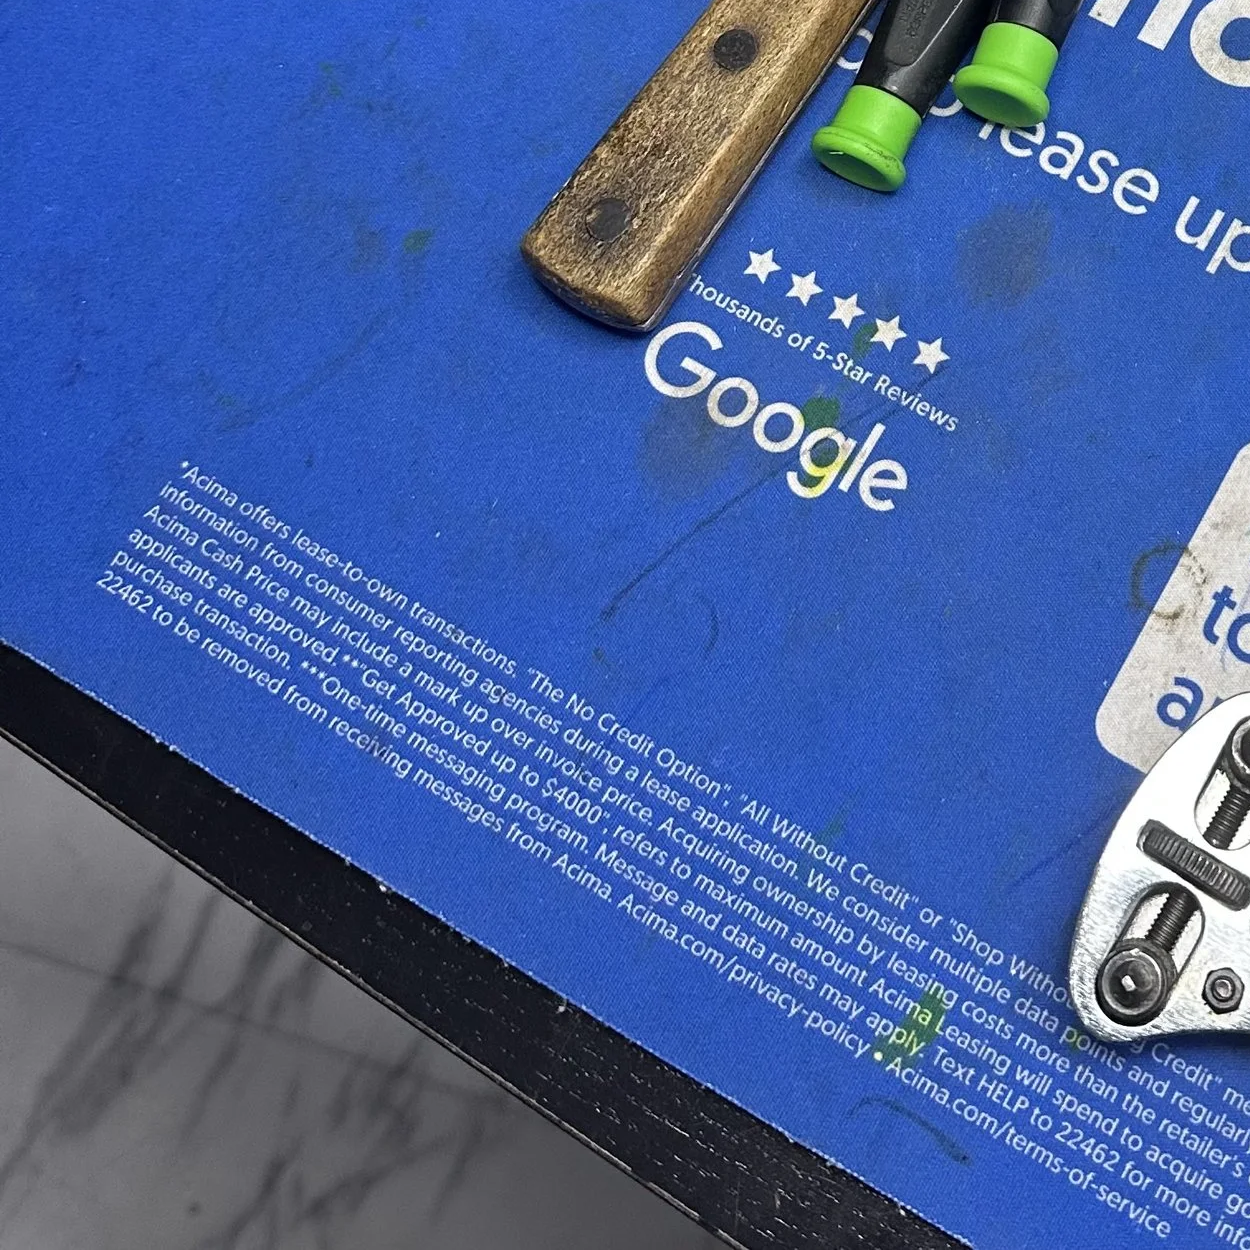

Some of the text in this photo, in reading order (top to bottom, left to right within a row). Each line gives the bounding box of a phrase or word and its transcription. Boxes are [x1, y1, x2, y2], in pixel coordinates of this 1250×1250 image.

[643, 320, 909, 512] Google
[689, 273, 959, 433] housands of 5-Star Reviews
[95, 569, 154, 613] 22462
[200, 636, 286, 694] removed
[282, 684, 327, 722] from
[327, 715, 413, 779] receiving
[412, 767, 504, 832] messages
[505, 822, 551, 861] from
[551, 853, 612, 902] Acima.
[616, 892, 870, 1058] Acima.com/privacy-policy
[884, 1056, 1171, 1238] Acima.com/terms-of-service
[109, 550, 193, 606] purchase
[193, 598, 290, 670] transaction.
[406, 731, 506, 802] messaging
[503, 792, 588, 854] program.
[593, 842, 679, 906] Message
[680, 899, 722, 931] and
[721, 924, 766, 959] data
[766, 951, 817, 990] rates
[818, 982, 865, 1020] may
[865, 1011, 925, 1057] apply.
[933, 1045, 975, 1085] Text
[976, 1073, 1029, 1113] HELP
[1054, 1121, 1120, 1171] 22462
[1120, 1160, 1153, 1190] for
[1153, 1183, 1211, 1226] more
[128, 528, 217, 589] applicants
[217, 583, 248, 608] are
[394, 691, 491, 756] Approved
[612, 824, 668, 866] refers
[692, 873, 789, 939] maximum
[789, 932, 868, 987] amount
[868, 977, 932, 1026] Acima
[934, 1014, 1011, 1076] Leasing
[1015, 1064, 1052, 1096] will
[1051, 1088, 1119, 1136] spend
[1145, 1144, 1223, 1199] acquire
[142, 504, 199, 546] Acima
[200, 538, 244, 574] Cash
[244, 564, 289, 601] Price
[289, 595, 332, 628] may
[330, 616, 398, 668] include
[413, 670, 461, 707] mark
[490, 717, 535, 749] over
[533, 739, 602, 792] invoice
[600, 785, 652, 826] price.
[656, 816, 750, 885] Acquiring
[752, 875, 854, 944] ownership
[886, 950, 959, 1010] leasing
[960, 1000, 1014, 1039] costs
[1015, 1031, 1070, 1073] more
[1073, 1064, 1118, 1103] than
[1121, 1092, 1156, 1124] the
[1157, 1117, 1244, 1178] retailer's
[159, 480, 258, 551] information
[259, 541, 304, 579] from
[304, 572, 393, 631] consumer
[392, 625, 479, 687] reporting
[478, 677, 562, 734] agencies
[562, 727, 624, 775] during
[639, 769, 691, 812] lease
[691, 805, 798, 880] application.
[806, 867, 839, 901] We
[841, 895, 929, 953] consider
[929, 946, 1011, 1003] multiple
[1013, 996, 1059, 1033] data
[1058, 1024, 1125, 1072] points
[1127, 1065, 1170, 1098] and
[238, 502, 291, 539] offers
[290, 528, 408, 610] lease-to-own
[409, 601, 516, 678] transactions.
[564, 692, 594, 721] No
[597, 712, 654, 757] Credit
[771, 813, 847, 873] Without
